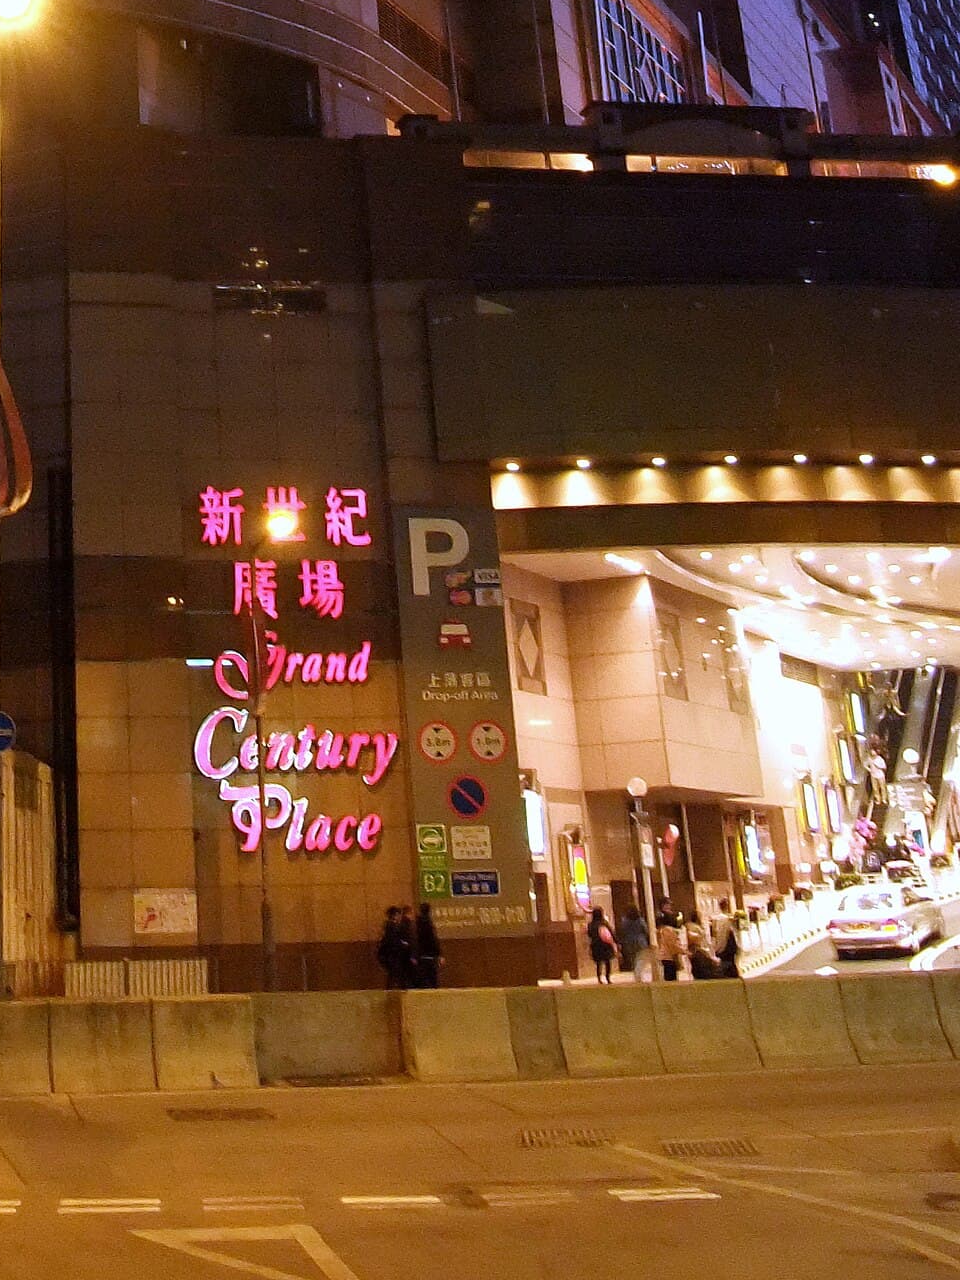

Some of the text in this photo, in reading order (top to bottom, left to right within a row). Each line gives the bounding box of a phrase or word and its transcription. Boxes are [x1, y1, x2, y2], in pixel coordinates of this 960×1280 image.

[198, 485, 372, 547] 新世紀
[233, 558, 345, 620] 廣場
[409, 517, 470, 596] P
[214, 629, 372, 701] Grand
[194, 704, 398, 786] Century
[219, 779, 382, 854] Place
